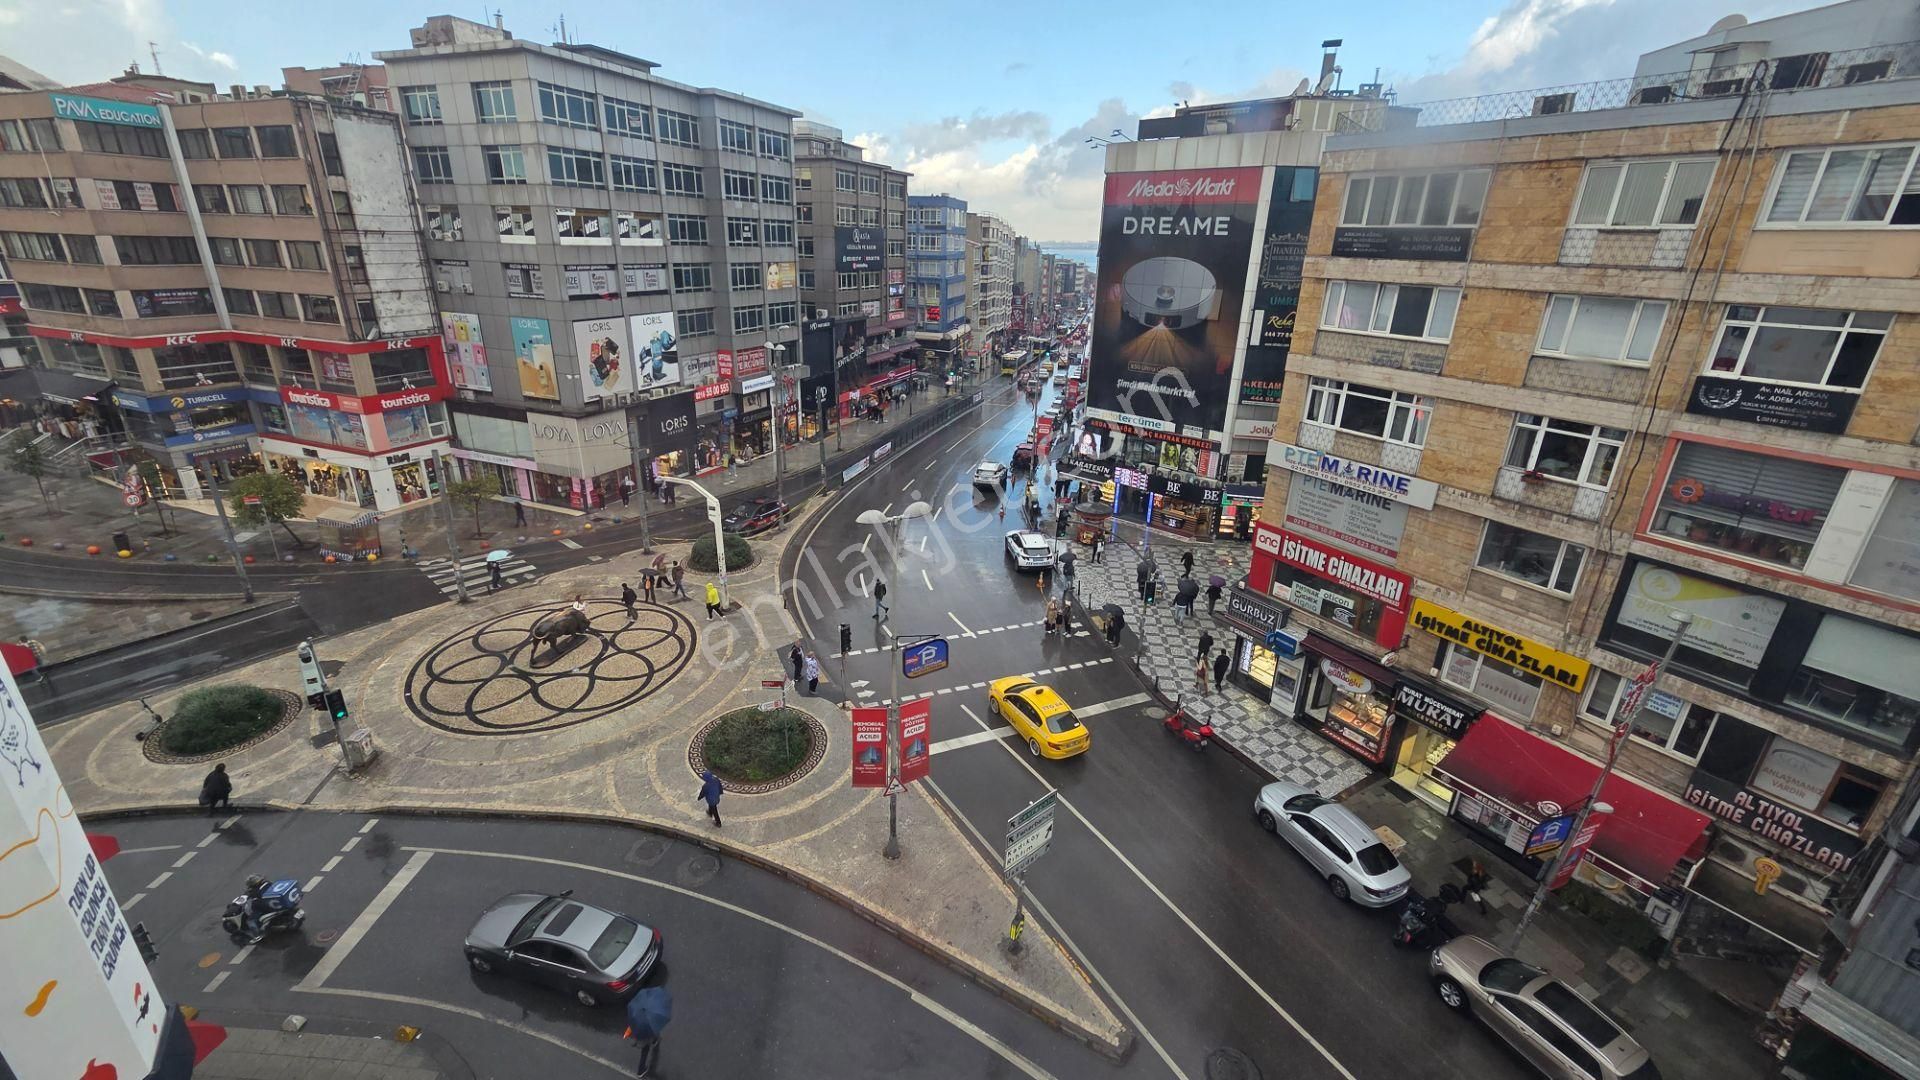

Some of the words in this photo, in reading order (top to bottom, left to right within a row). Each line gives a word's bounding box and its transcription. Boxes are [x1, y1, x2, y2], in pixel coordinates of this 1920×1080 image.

[55, 97, 98, 119] PAVA
[99, 108, 161, 126] EDUCATION
[1127, 178, 1175, 197] Media
[1189, 177, 1236, 197] Markt
[1122, 216, 1231, 236] DREAME
[518, 319, 540, 330] LORIS
[588, 322, 612, 333] LORIS
[642, 316, 662, 326] LORIS
[71, 332, 84, 342] KFC
[166, 334, 197, 346] KFC
[280, 337, 297, 348] KFC
[387, 338, 413, 350] KFC
[1251, 380, 1282, 390] KELAM
[187, 393, 227, 405] TURKCELL
[287, 390, 331, 408] touristica
[381, 392, 431, 409] touristica
[1768, 394, 1793, 404] ADEM
[532, 423, 575, 444] LOYA
[584, 418, 624, 441] LOYA
[661, 414, 688, 434] LORIS
[1249, 425, 1273, 436] Jolly
[1154, 431, 1180, 443] KAYNAK
[1181, 437, 1212, 449] MERKEZİ
[1069, 460, 1110, 474] KARATEKİN
[1166, 481, 1181, 494] BE
[1203, 489, 1219, 502] BE
[1281, 535, 1327, 572] İŞİTME
[1327, 556, 1404, 602] CİHAZLARI
[1323, 592, 1350, 607] oticon
[1461, 619, 1525, 652] ALTIYOL
[1414, 610, 1470, 644] İŞİTME
[1475, 637, 1580, 688] CİHAZLARI
[1474, 792, 1514, 818] MERKEZ
[1750, 816, 1854, 873] CİHAZLARI
[69, 872, 90, 919] TURN
[83, 853, 96, 881] UP
[80, 876, 108, 940] CRUNCH
[90, 918, 111, 962] TURN
[105, 896, 117, 925] UP
[102, 919, 127, 981] CRUNCH
